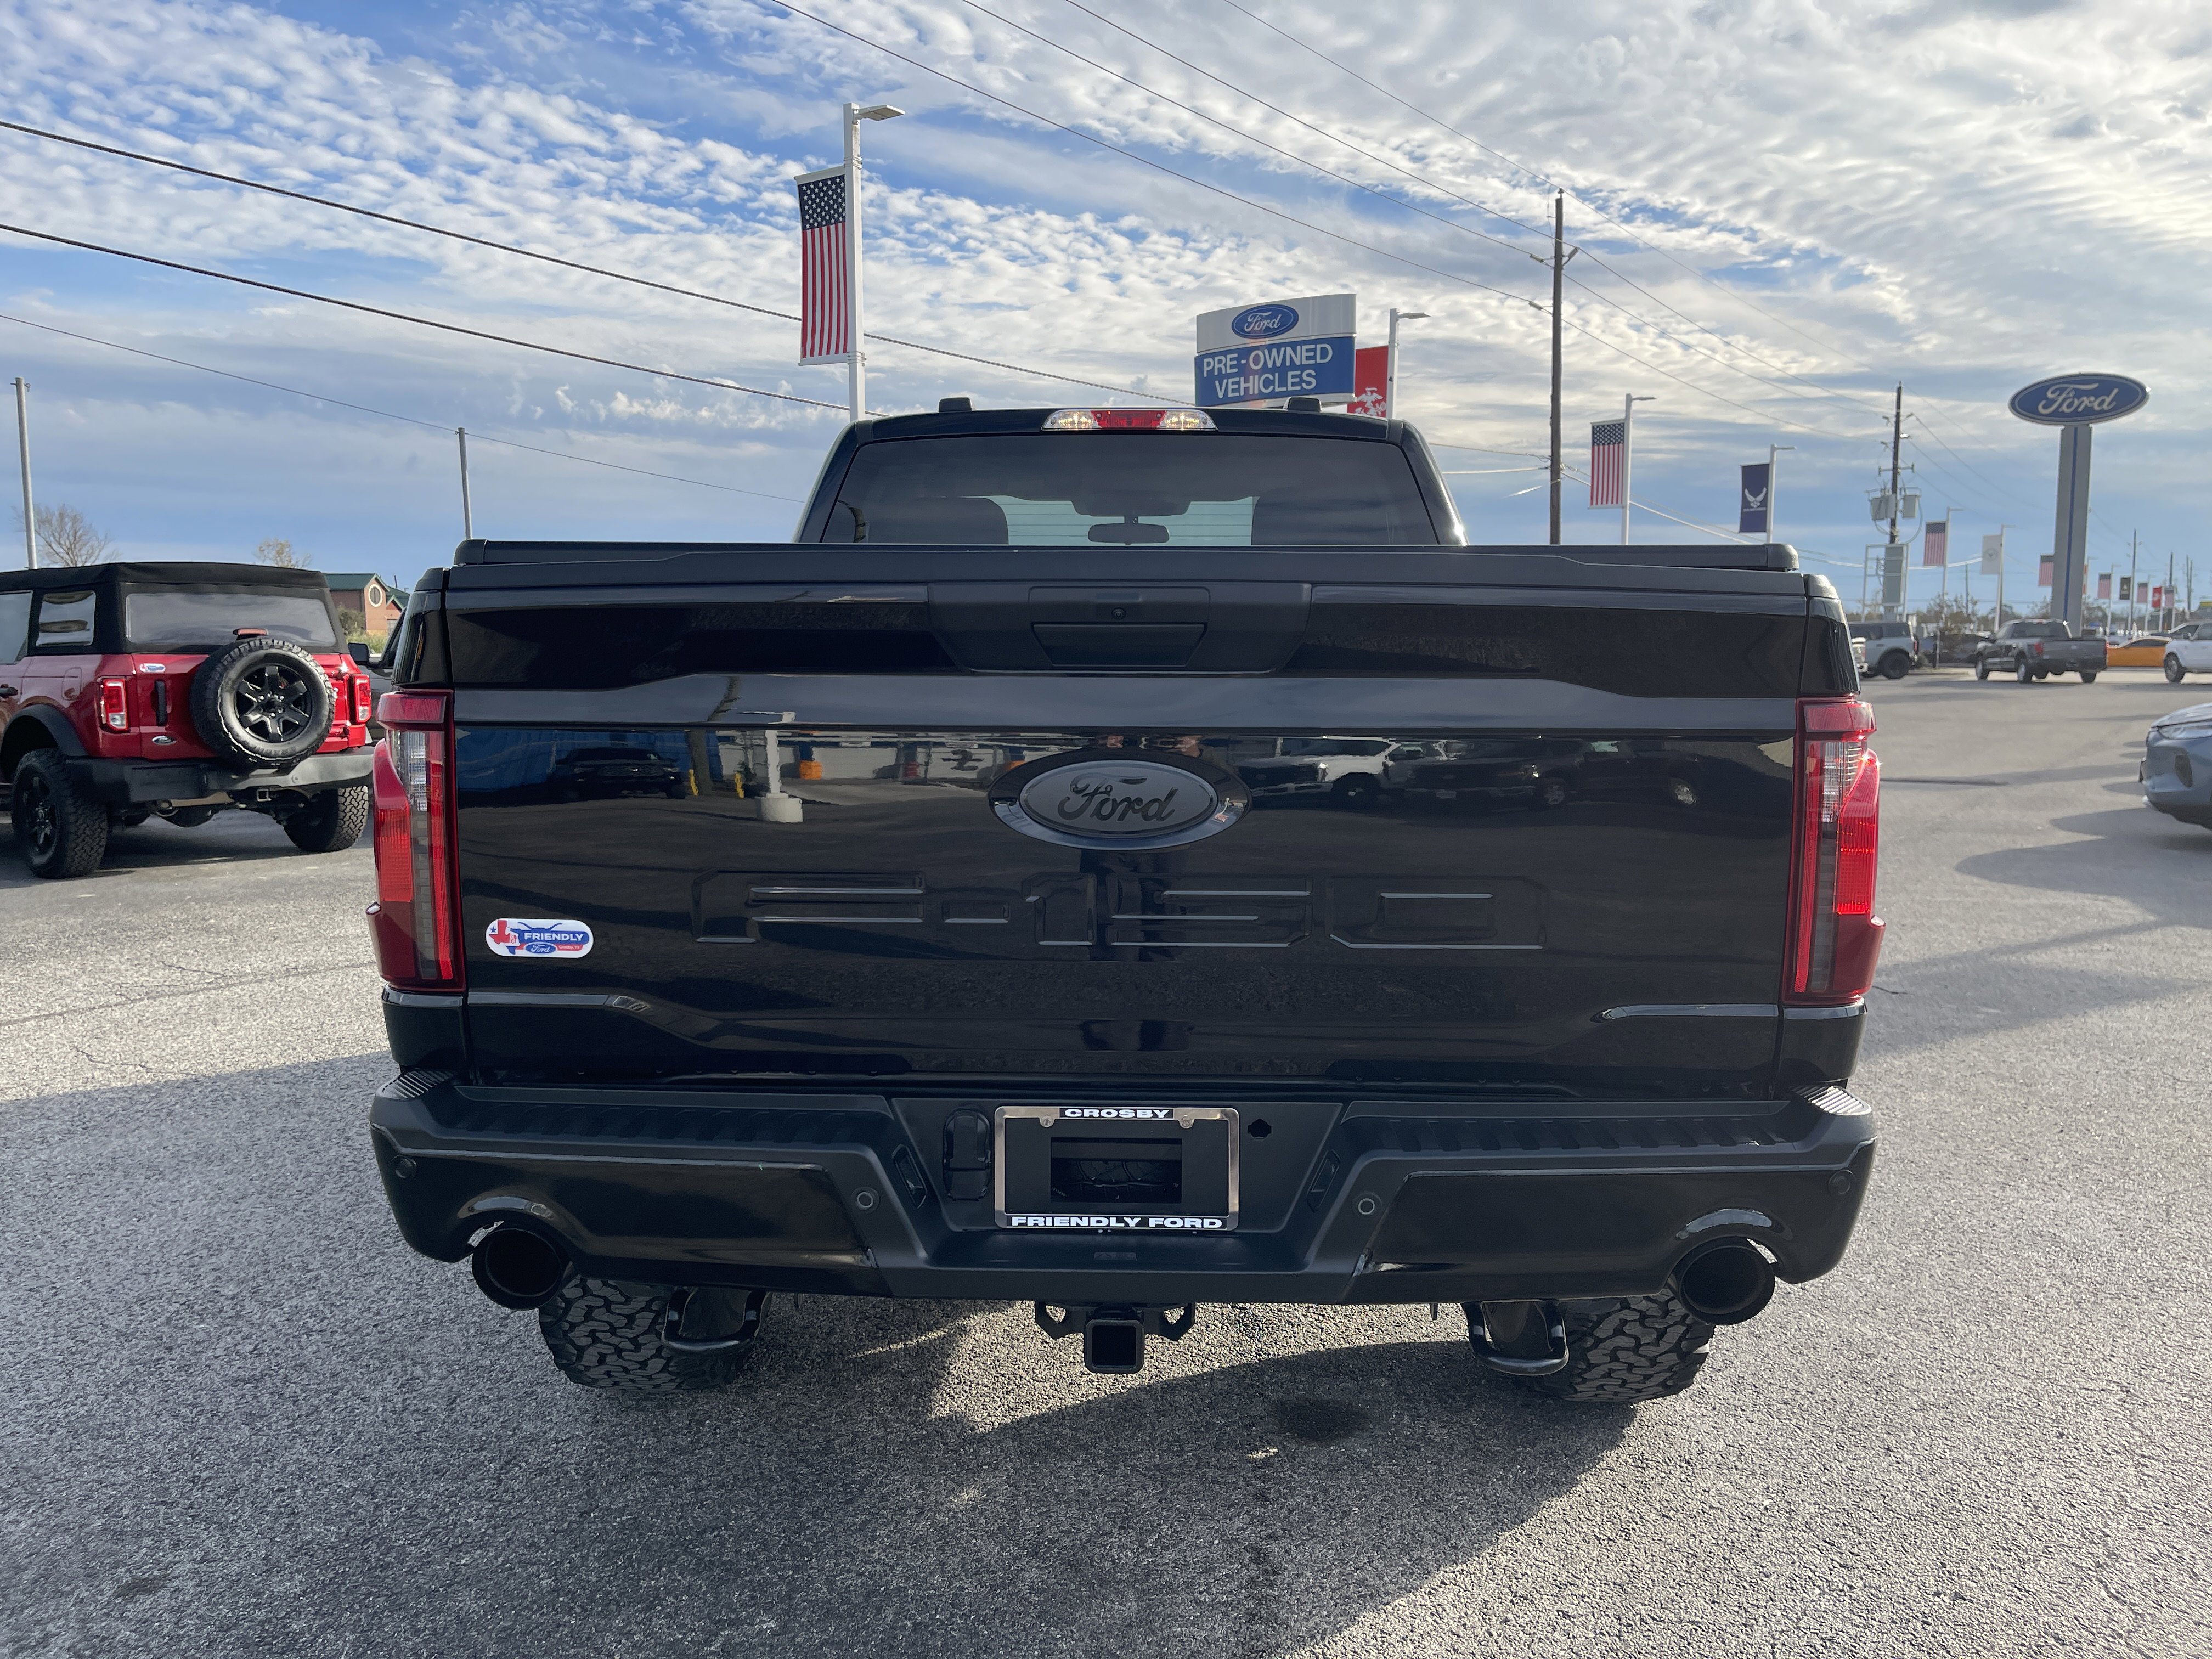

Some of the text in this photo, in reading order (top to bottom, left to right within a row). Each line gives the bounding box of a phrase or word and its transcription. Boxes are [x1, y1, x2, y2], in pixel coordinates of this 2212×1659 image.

[1244, 311, 1282, 332] Ford
[1215, 369, 1317, 399] VEHICLES
[2038, 382, 2119, 415] Ford
[1057, 772, 1179, 822] Ford
[524, 932, 584, 941] FRIENDLY
[531, 944, 551, 952] Ford
[1064, 1108, 1169, 1119] CROSBY
[1011, 1216, 1222, 1229] FRIENDLY FORD
